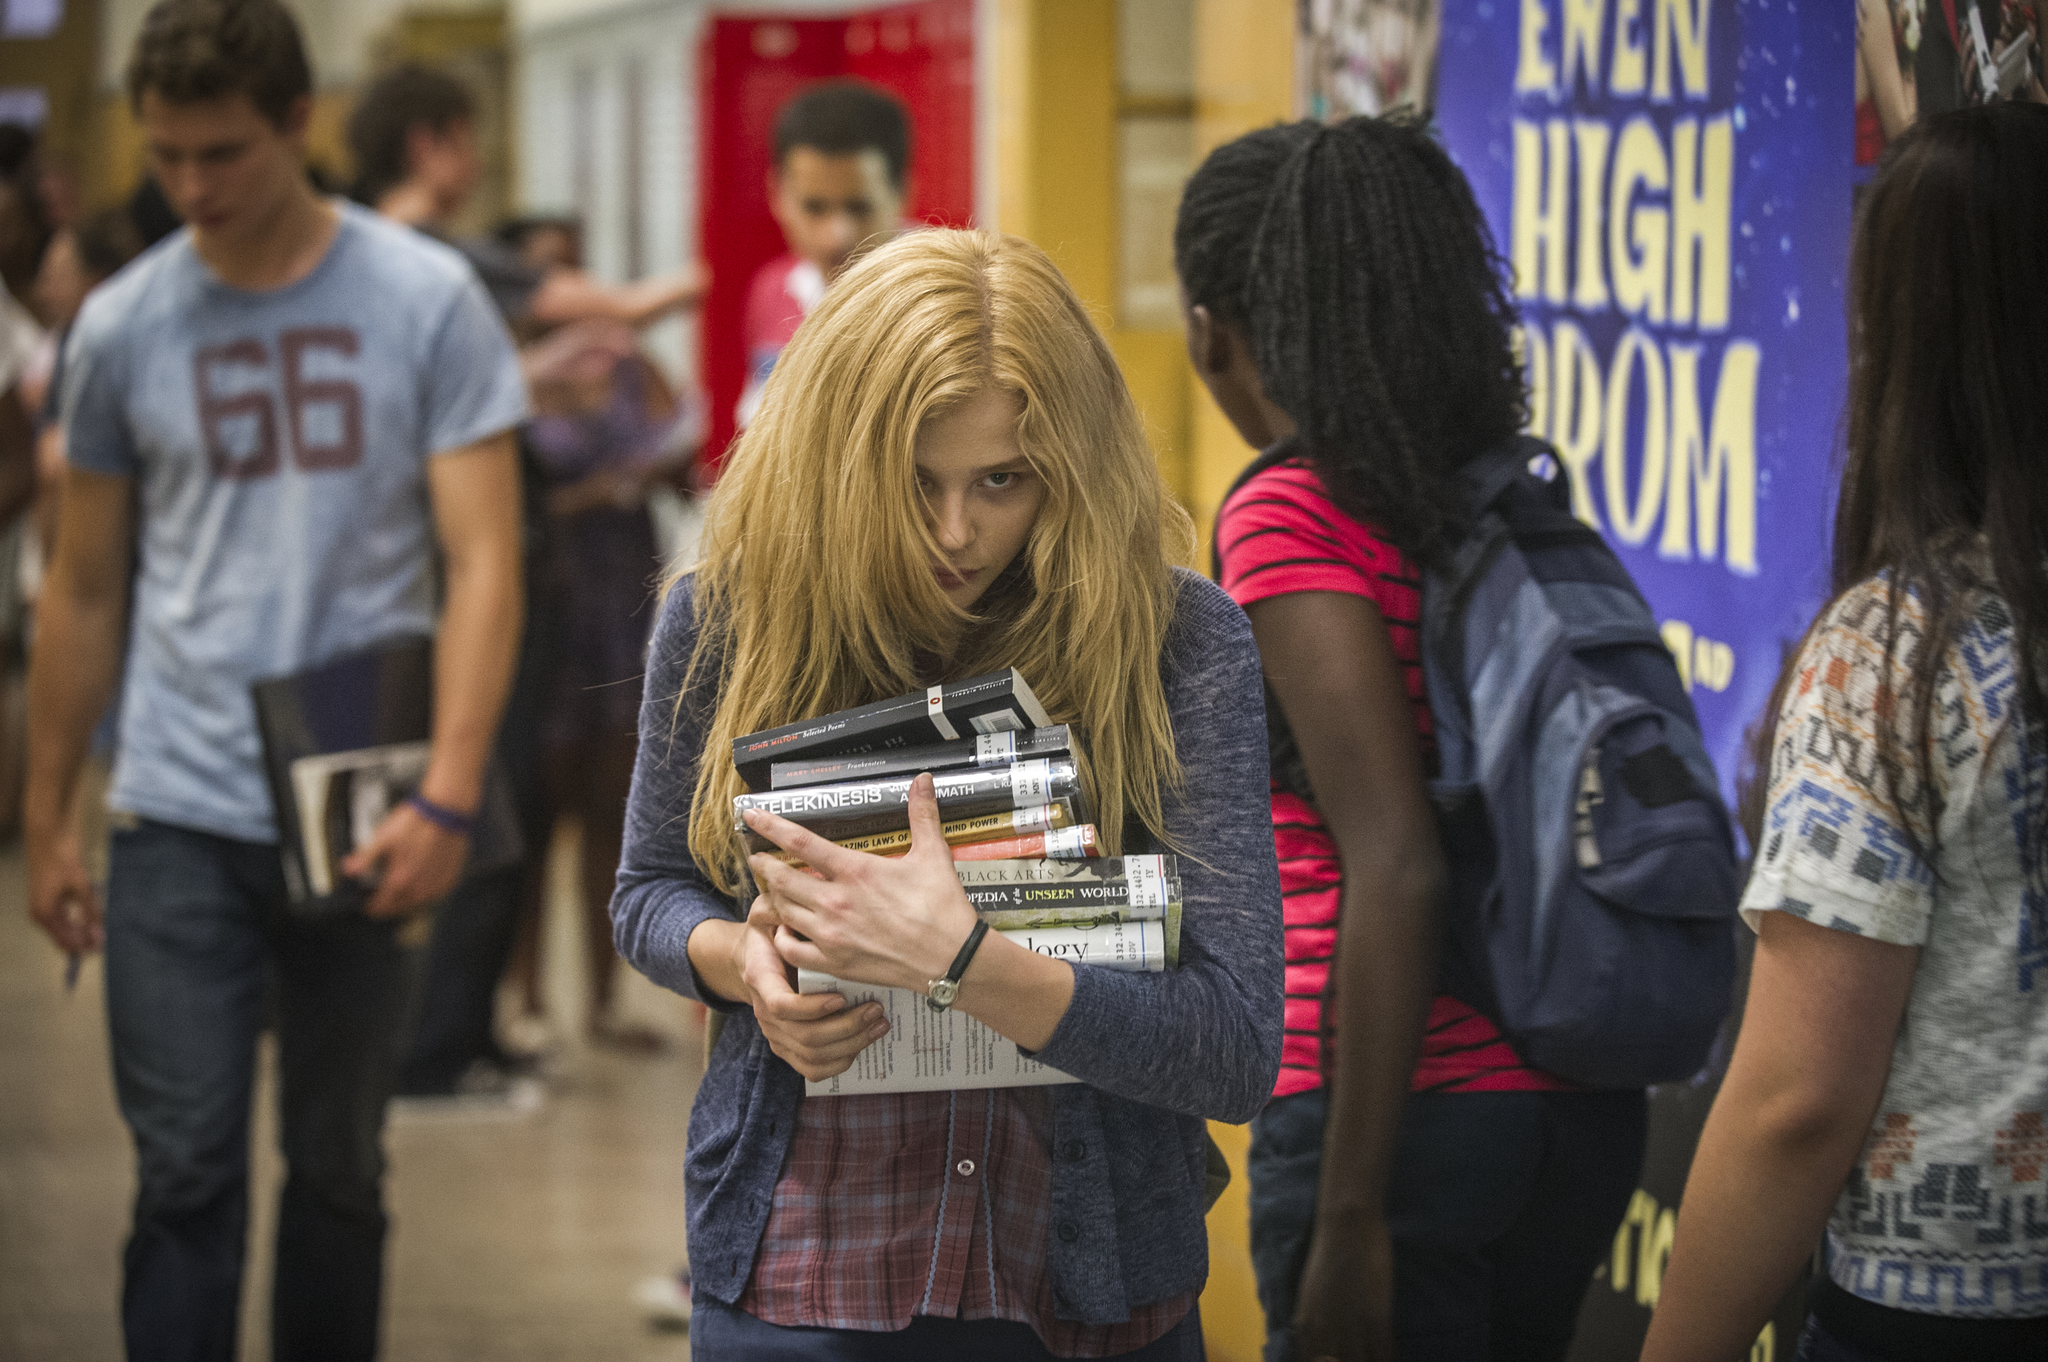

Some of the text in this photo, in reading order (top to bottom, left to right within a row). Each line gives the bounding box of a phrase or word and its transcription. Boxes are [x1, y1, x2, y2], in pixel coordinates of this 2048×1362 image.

[1512, 114, 1735, 331] HIGH
[194, 326, 365, 481] 66
[748, 721, 847, 752] JOHN MILTON Selected Poems
[786, 759, 887, 778] MARY SHELLEY Frankenstein
[757, 787, 883, 815] TELEKINESIS
[944, 817, 999, 834] MIND POWER
[872, 834, 895, 846] LAWS
[897, 832, 909, 843] OF
[958, 868, 1054, 882] BLACK ARTS
[1025, 889, 1075, 901] UNSEEN
